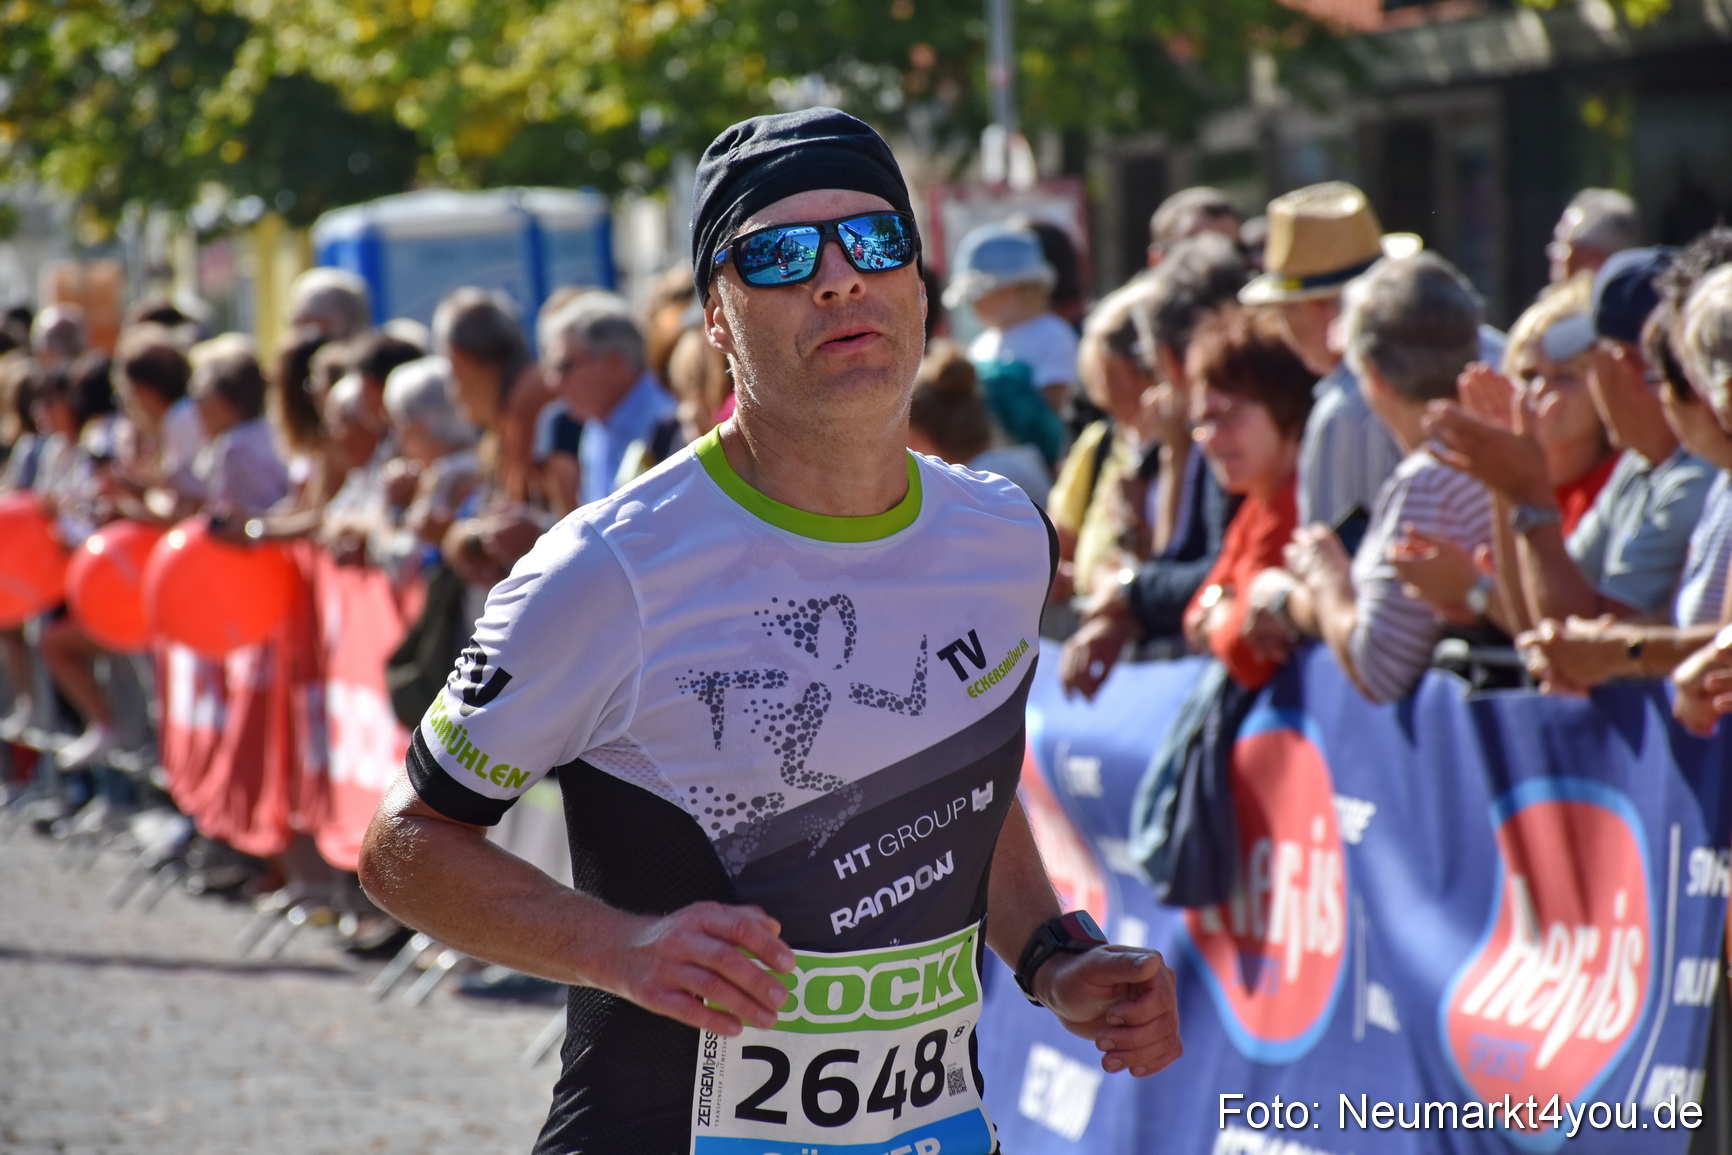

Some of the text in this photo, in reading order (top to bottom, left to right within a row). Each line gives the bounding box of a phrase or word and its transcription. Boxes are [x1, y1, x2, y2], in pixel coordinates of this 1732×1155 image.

[936, 628, 987, 682] TV
[966, 637, 1030, 699] ECKERSMÜHLEN
[833, 797, 967, 880] HT GROUP
[830, 850, 955, 936] RANDOW
[1203, 815, 1344, 986] ervis
[954, 1025, 965, 1038] B
[714, 1036, 728, 1127] TRANSPONDER ZEITMESSUN
[735, 1029, 949, 1128] 2648
